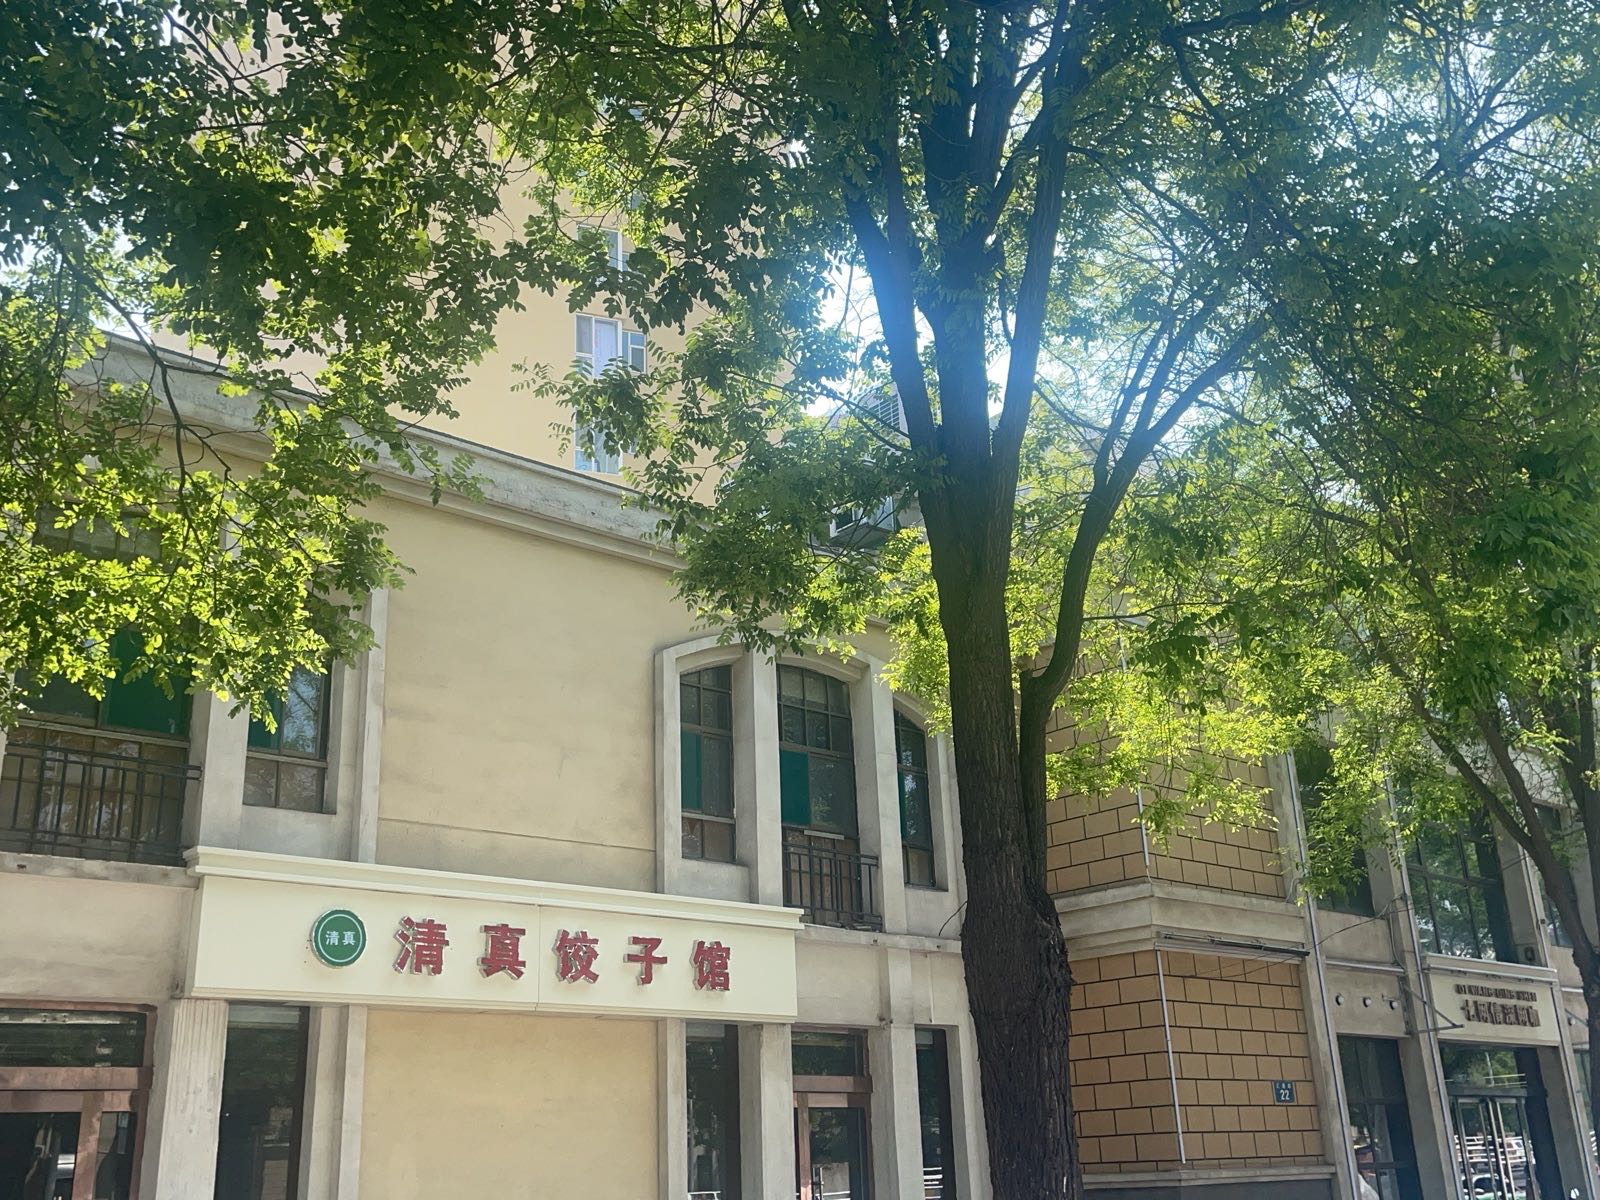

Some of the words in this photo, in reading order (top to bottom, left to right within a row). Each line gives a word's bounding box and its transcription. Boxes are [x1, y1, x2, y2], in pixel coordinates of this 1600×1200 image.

[325, 930, 356, 946] 清真
[393, 915, 732, 992] 清真饺子馆
[1280, 1089, 1290, 1100] 22
